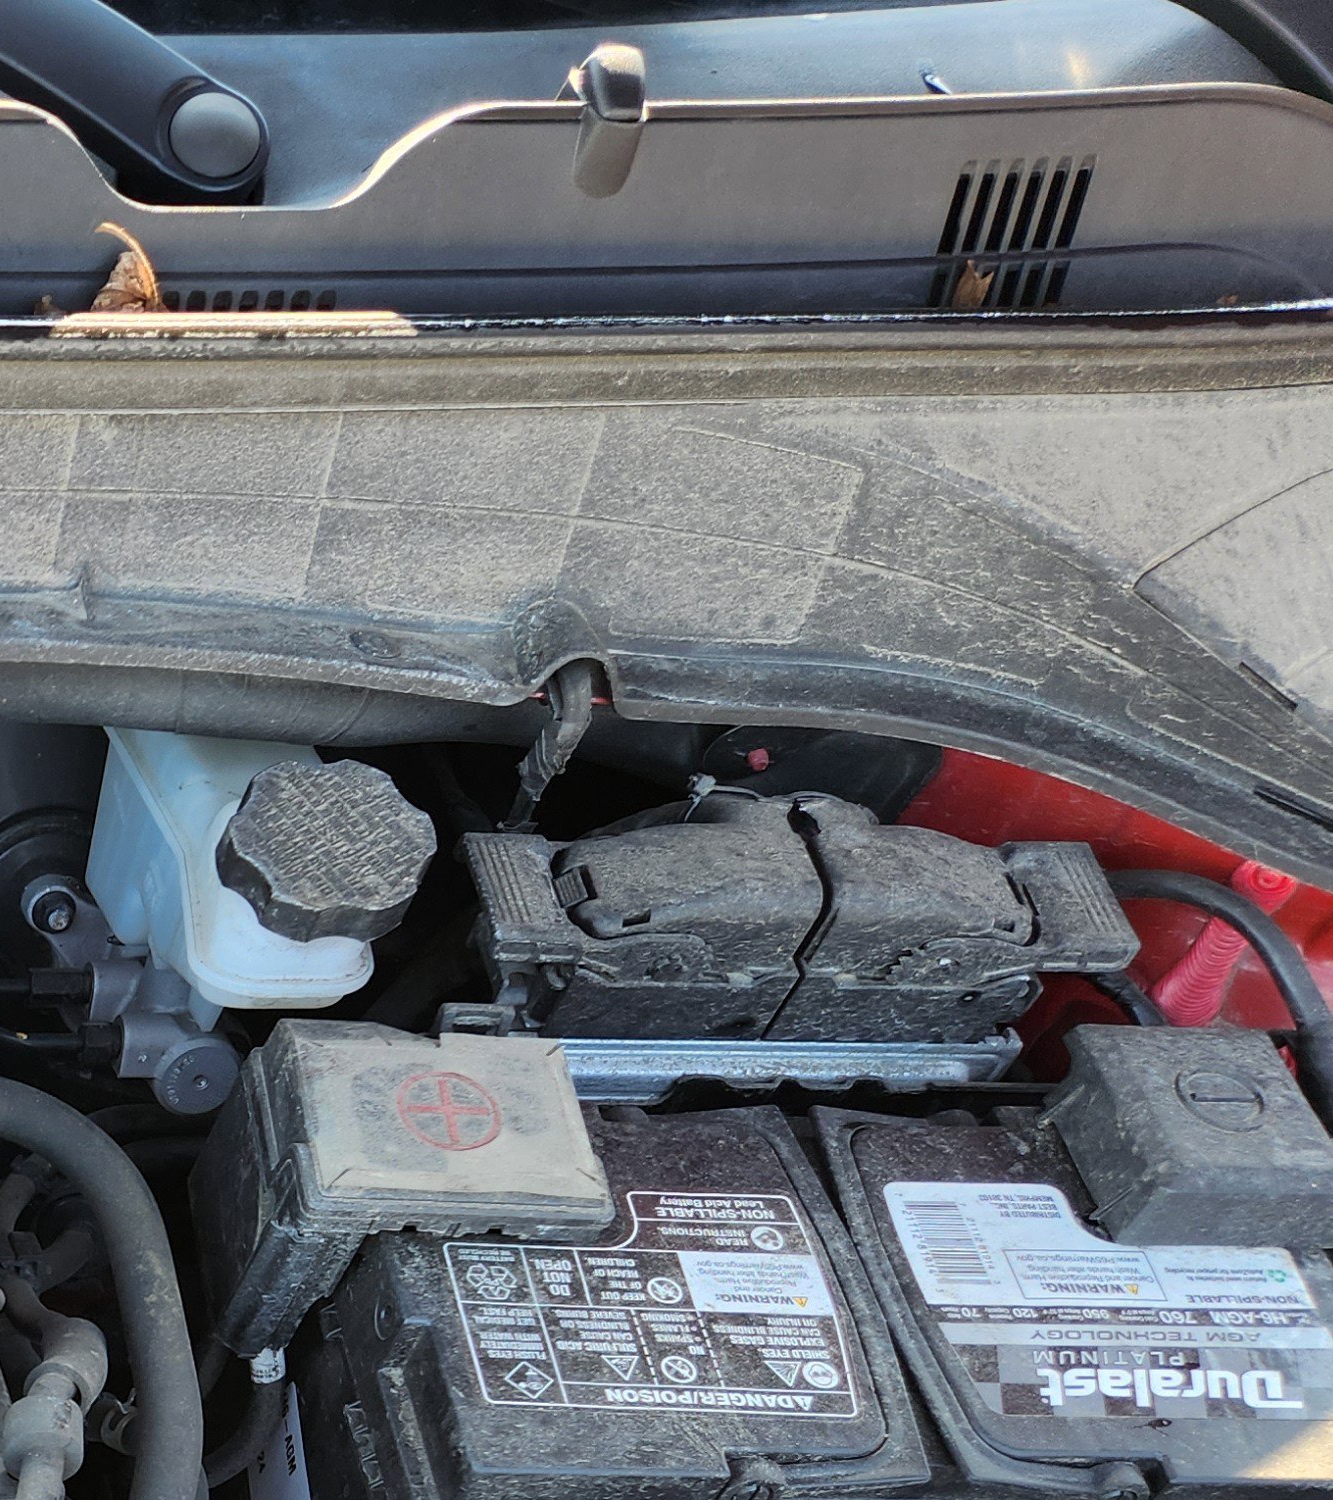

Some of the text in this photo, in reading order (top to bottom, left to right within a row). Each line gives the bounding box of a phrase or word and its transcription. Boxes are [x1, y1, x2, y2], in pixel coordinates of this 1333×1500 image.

[660, 1196, 764, 1208] Lead Acid Battery
[655, 1207, 774, 1219] NON-SPILLABLE
[657, 1227, 745, 1236] INSTRUCTIONS.
[716, 1238, 748, 1246] READ
[529, 1259, 572, 1270] OPEN.
[543, 1272, 571, 1282] NOT
[549, 1284, 571, 1295] DO
[1041, 1283, 1126, 1294] WARNING:
[715, 1294, 794, 1305] WARNING:
[1184, 1294, 1299, 1304] NON-SPILLABLE
[961, 1307, 982, 1318] 70
[1013, 1308, 1038, 1319] 120
[1083, 1309, 1109, 1320] 950
[1159, 1310, 1198, 1324] 760
[1209, 1310, 1288, 1325] H6-AGM
[730, 1336, 825, 1346] EXPLOSIVE GASES
[1030, 1330, 1262, 1342] AGM TECHNOLOGY
[791, 1349, 830, 1359] SHIELD
[1033, 1350, 1184, 1366] PLATINUM
[1036, 1368, 1303, 1409] Duralast
[605, 1388, 792, 1408] DANGER/POISON
